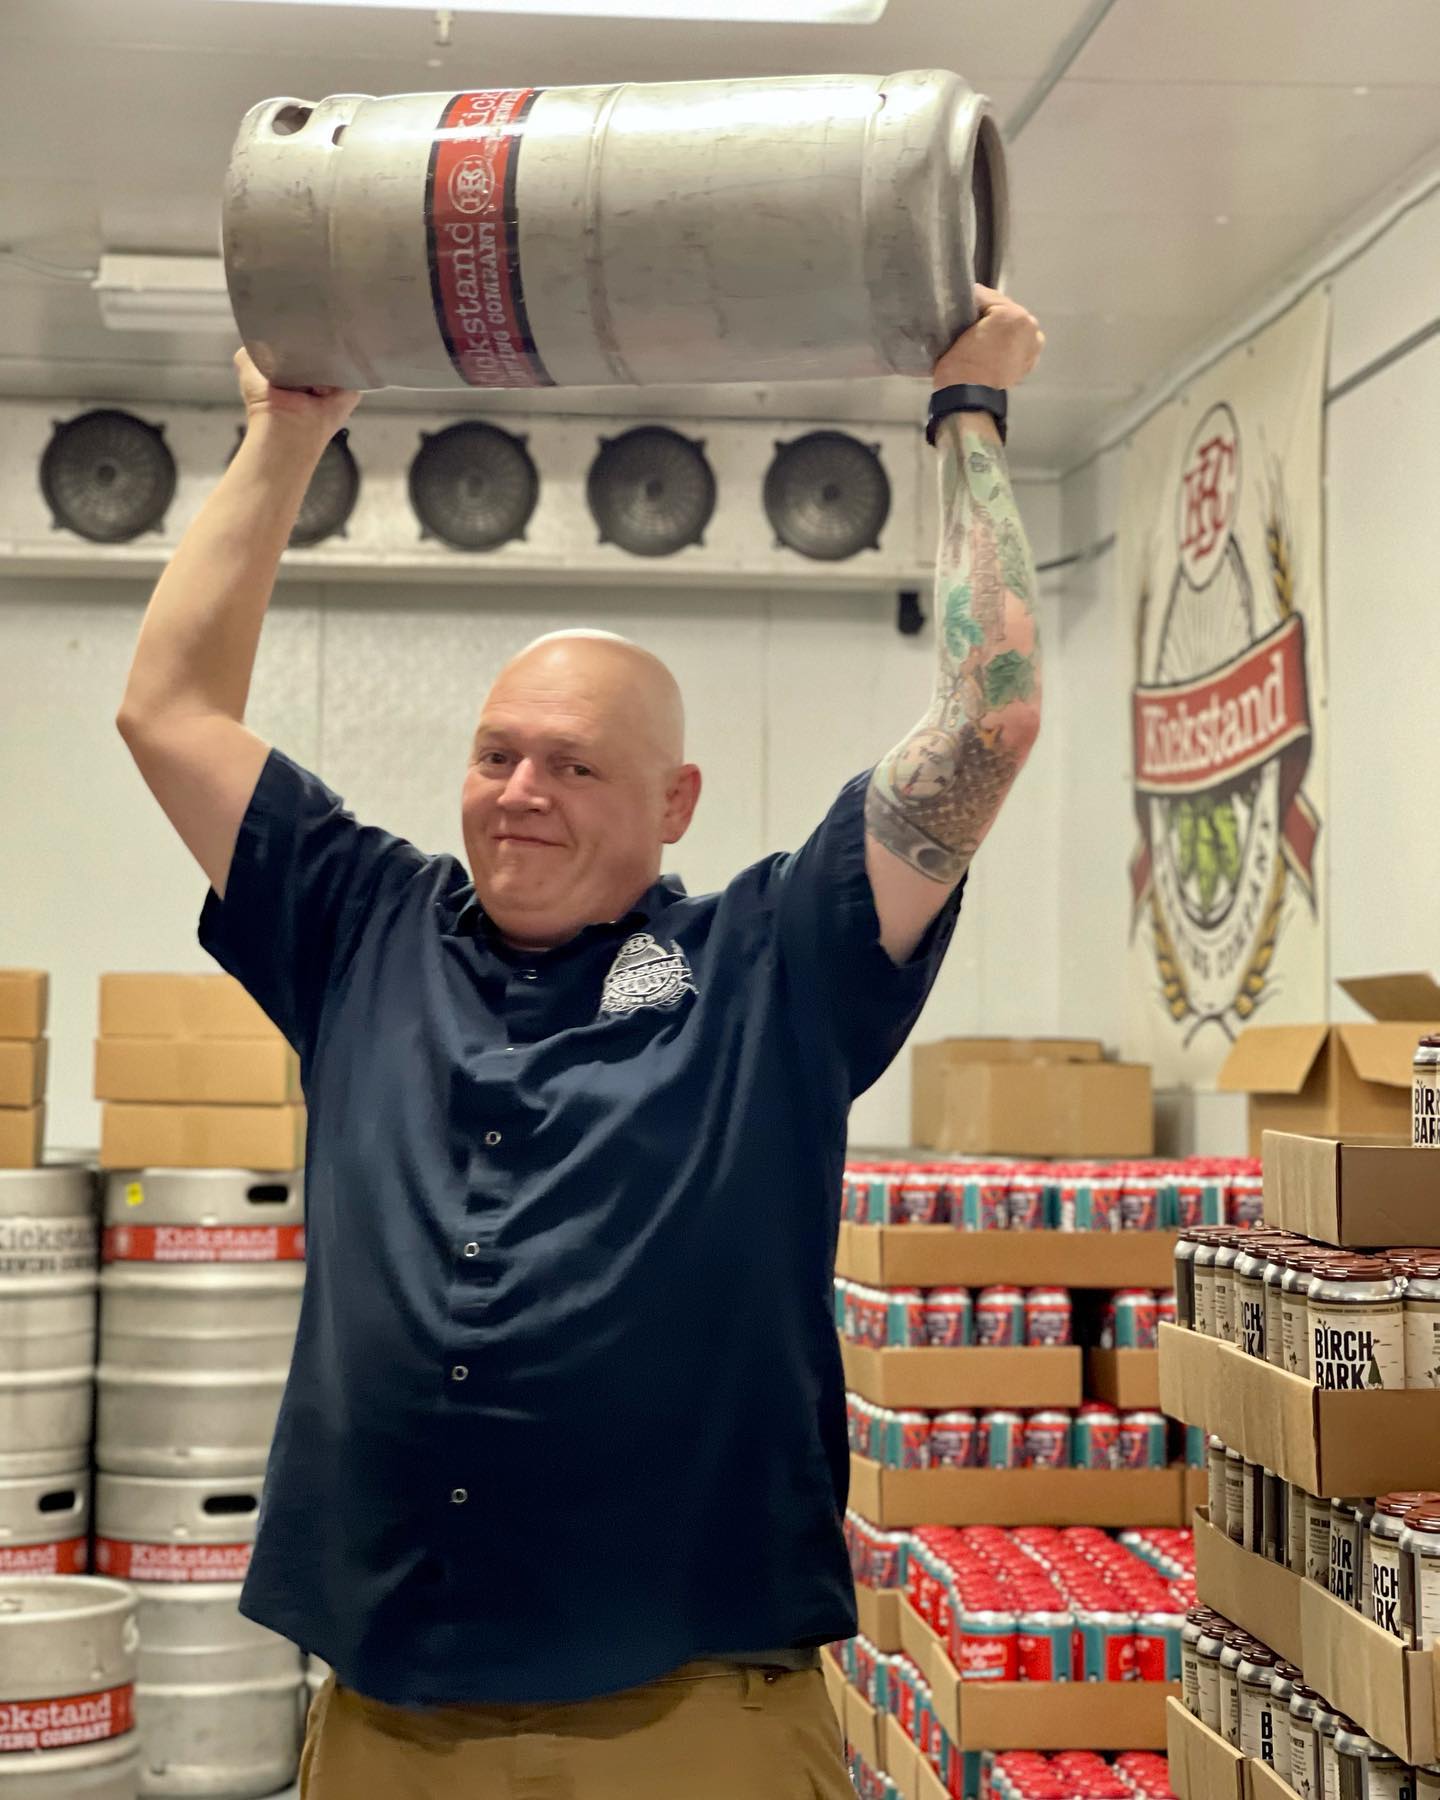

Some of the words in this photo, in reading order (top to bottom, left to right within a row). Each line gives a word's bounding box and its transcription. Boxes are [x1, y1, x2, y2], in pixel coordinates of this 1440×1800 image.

[479, 222, 507, 325] COMPANY
[1142, 651, 1286, 775] Kickstand
[1314, 1328, 1373, 1361] BIRCH
[1315, 1360, 1366, 1390] BARK
